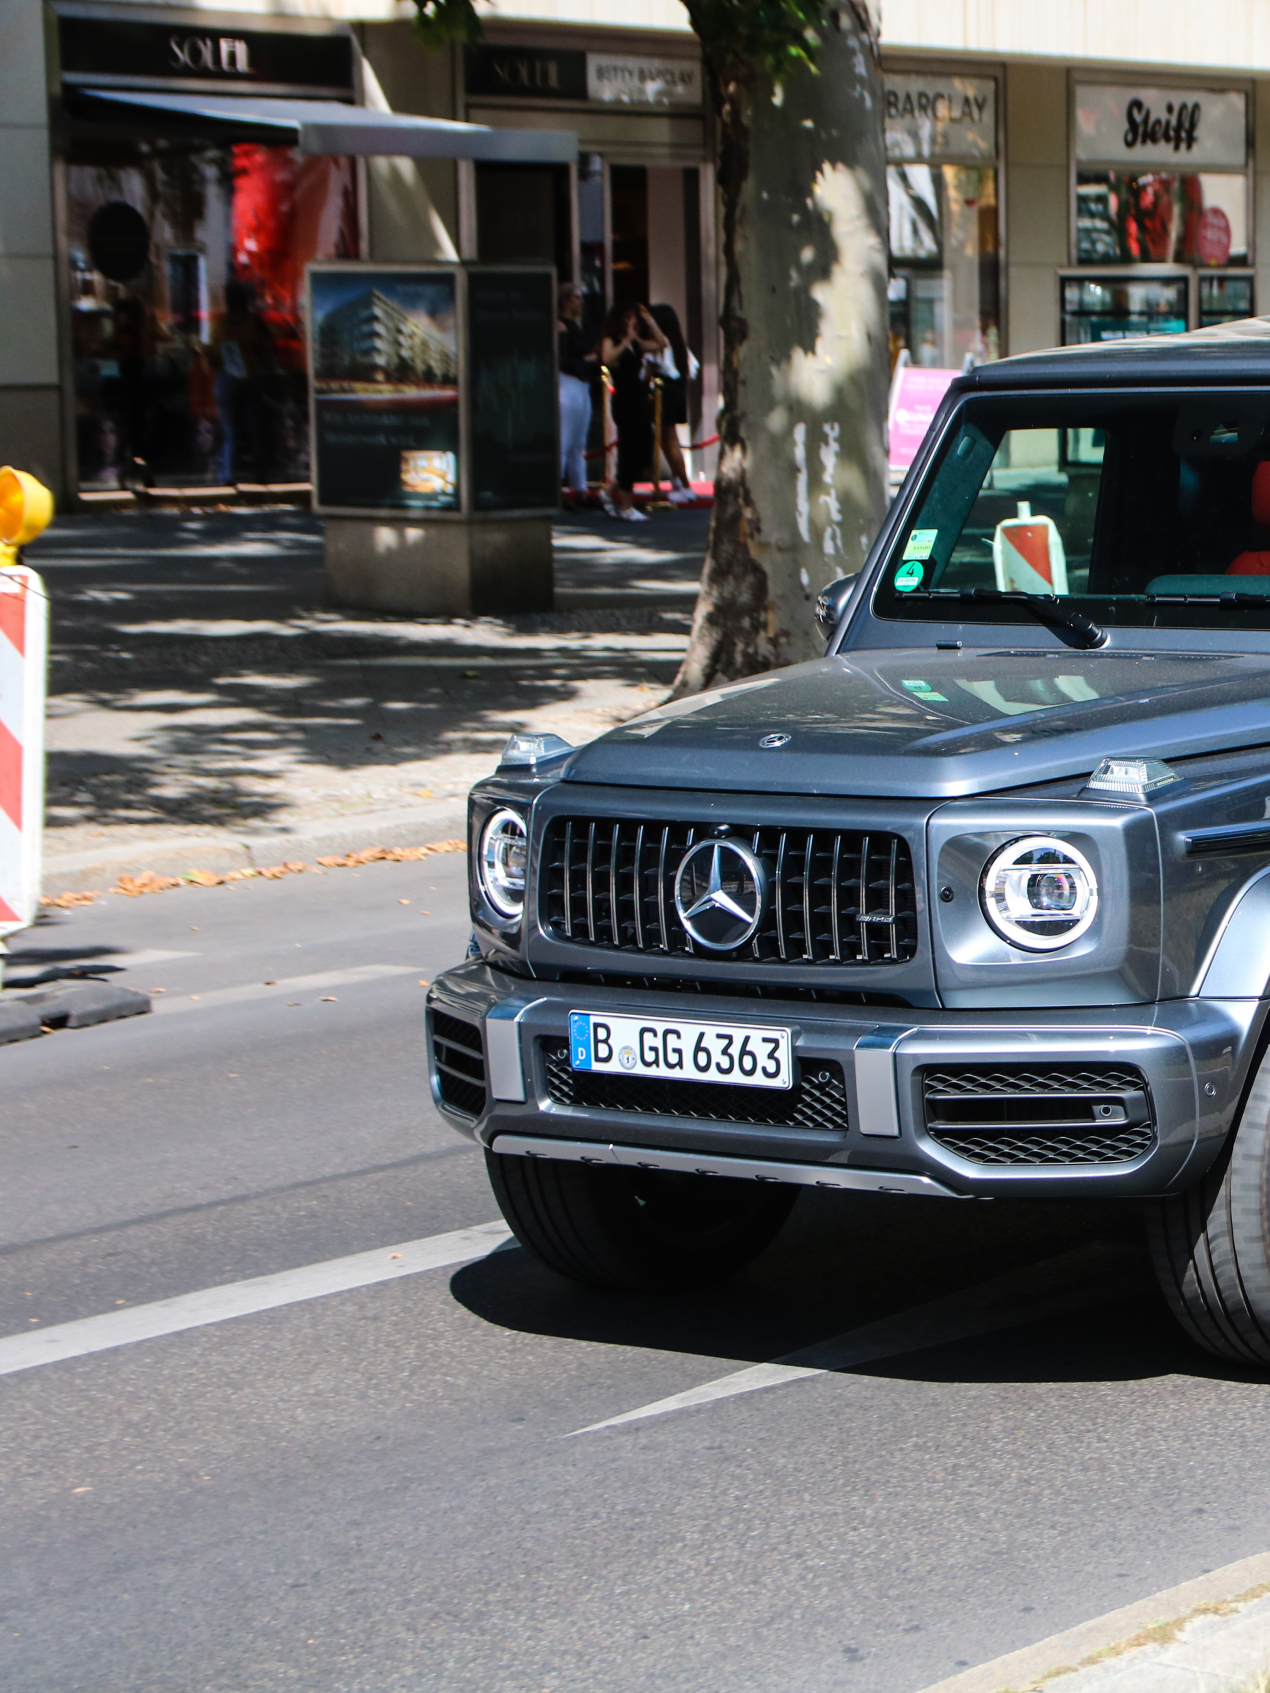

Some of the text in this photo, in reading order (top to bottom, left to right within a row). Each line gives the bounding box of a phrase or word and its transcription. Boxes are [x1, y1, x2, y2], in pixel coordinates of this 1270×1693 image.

[168, 35, 256, 73] SOLEIL
[885, 89, 987, 123] BARCLAY
[1124, 97, 1199, 151] Steiff
[906, 562, 916, 577] 4
[577, 1046, 587, 1060] D
[592, 1021, 782, 1079] B GG 6363
